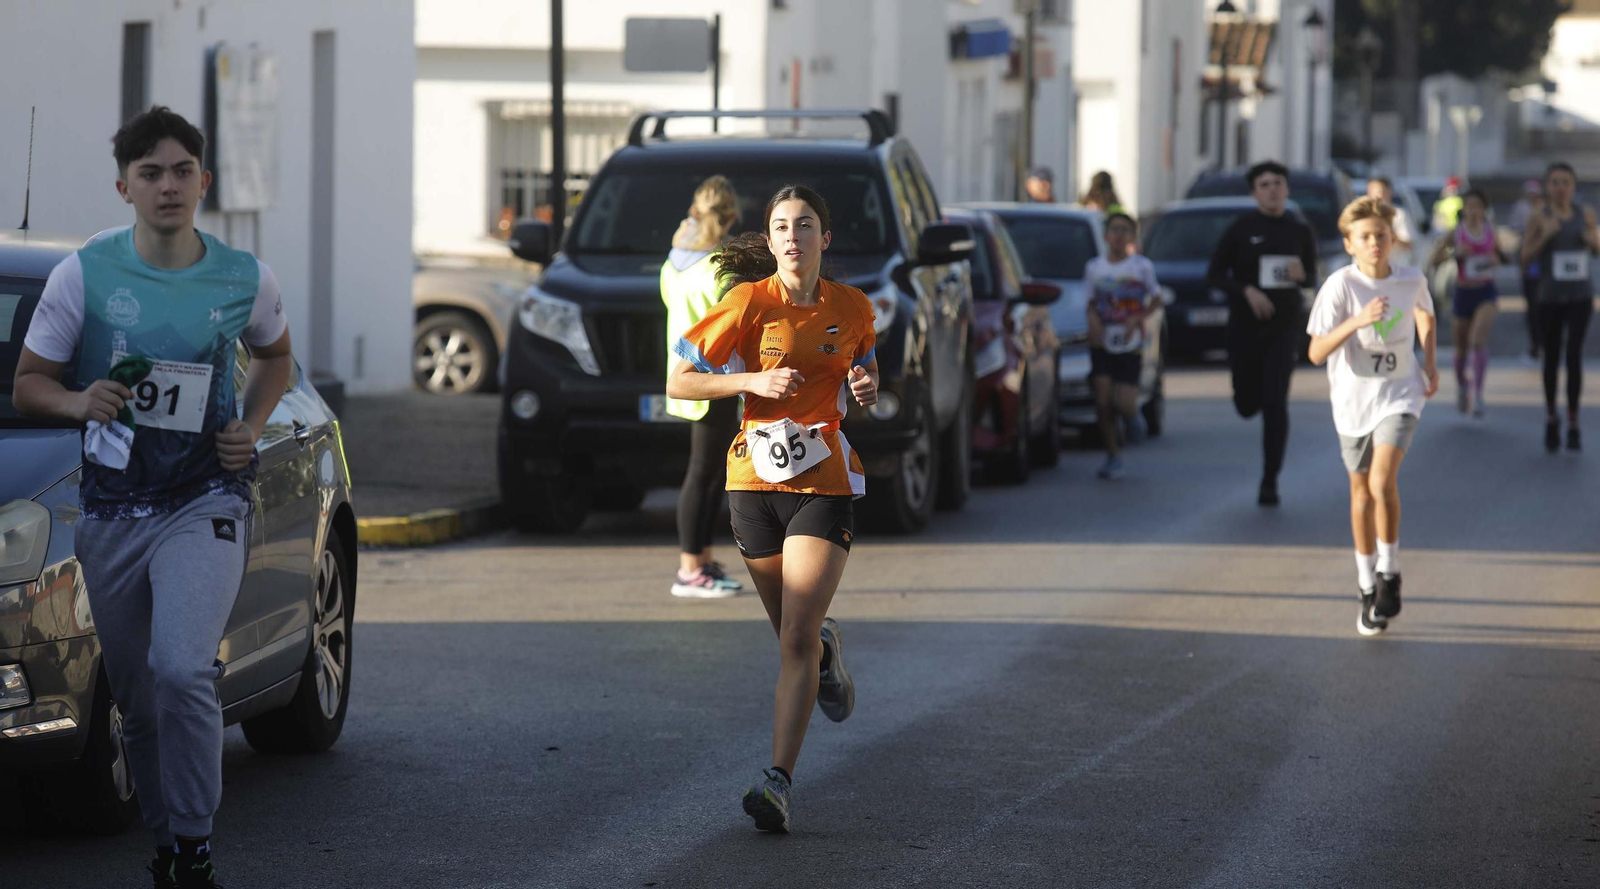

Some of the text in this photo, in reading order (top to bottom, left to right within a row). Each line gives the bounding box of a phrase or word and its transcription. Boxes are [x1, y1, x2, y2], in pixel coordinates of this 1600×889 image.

[1370, 351, 1398, 373] 79
[134, 380, 181, 416] 91
[770, 432, 807, 469] 95
